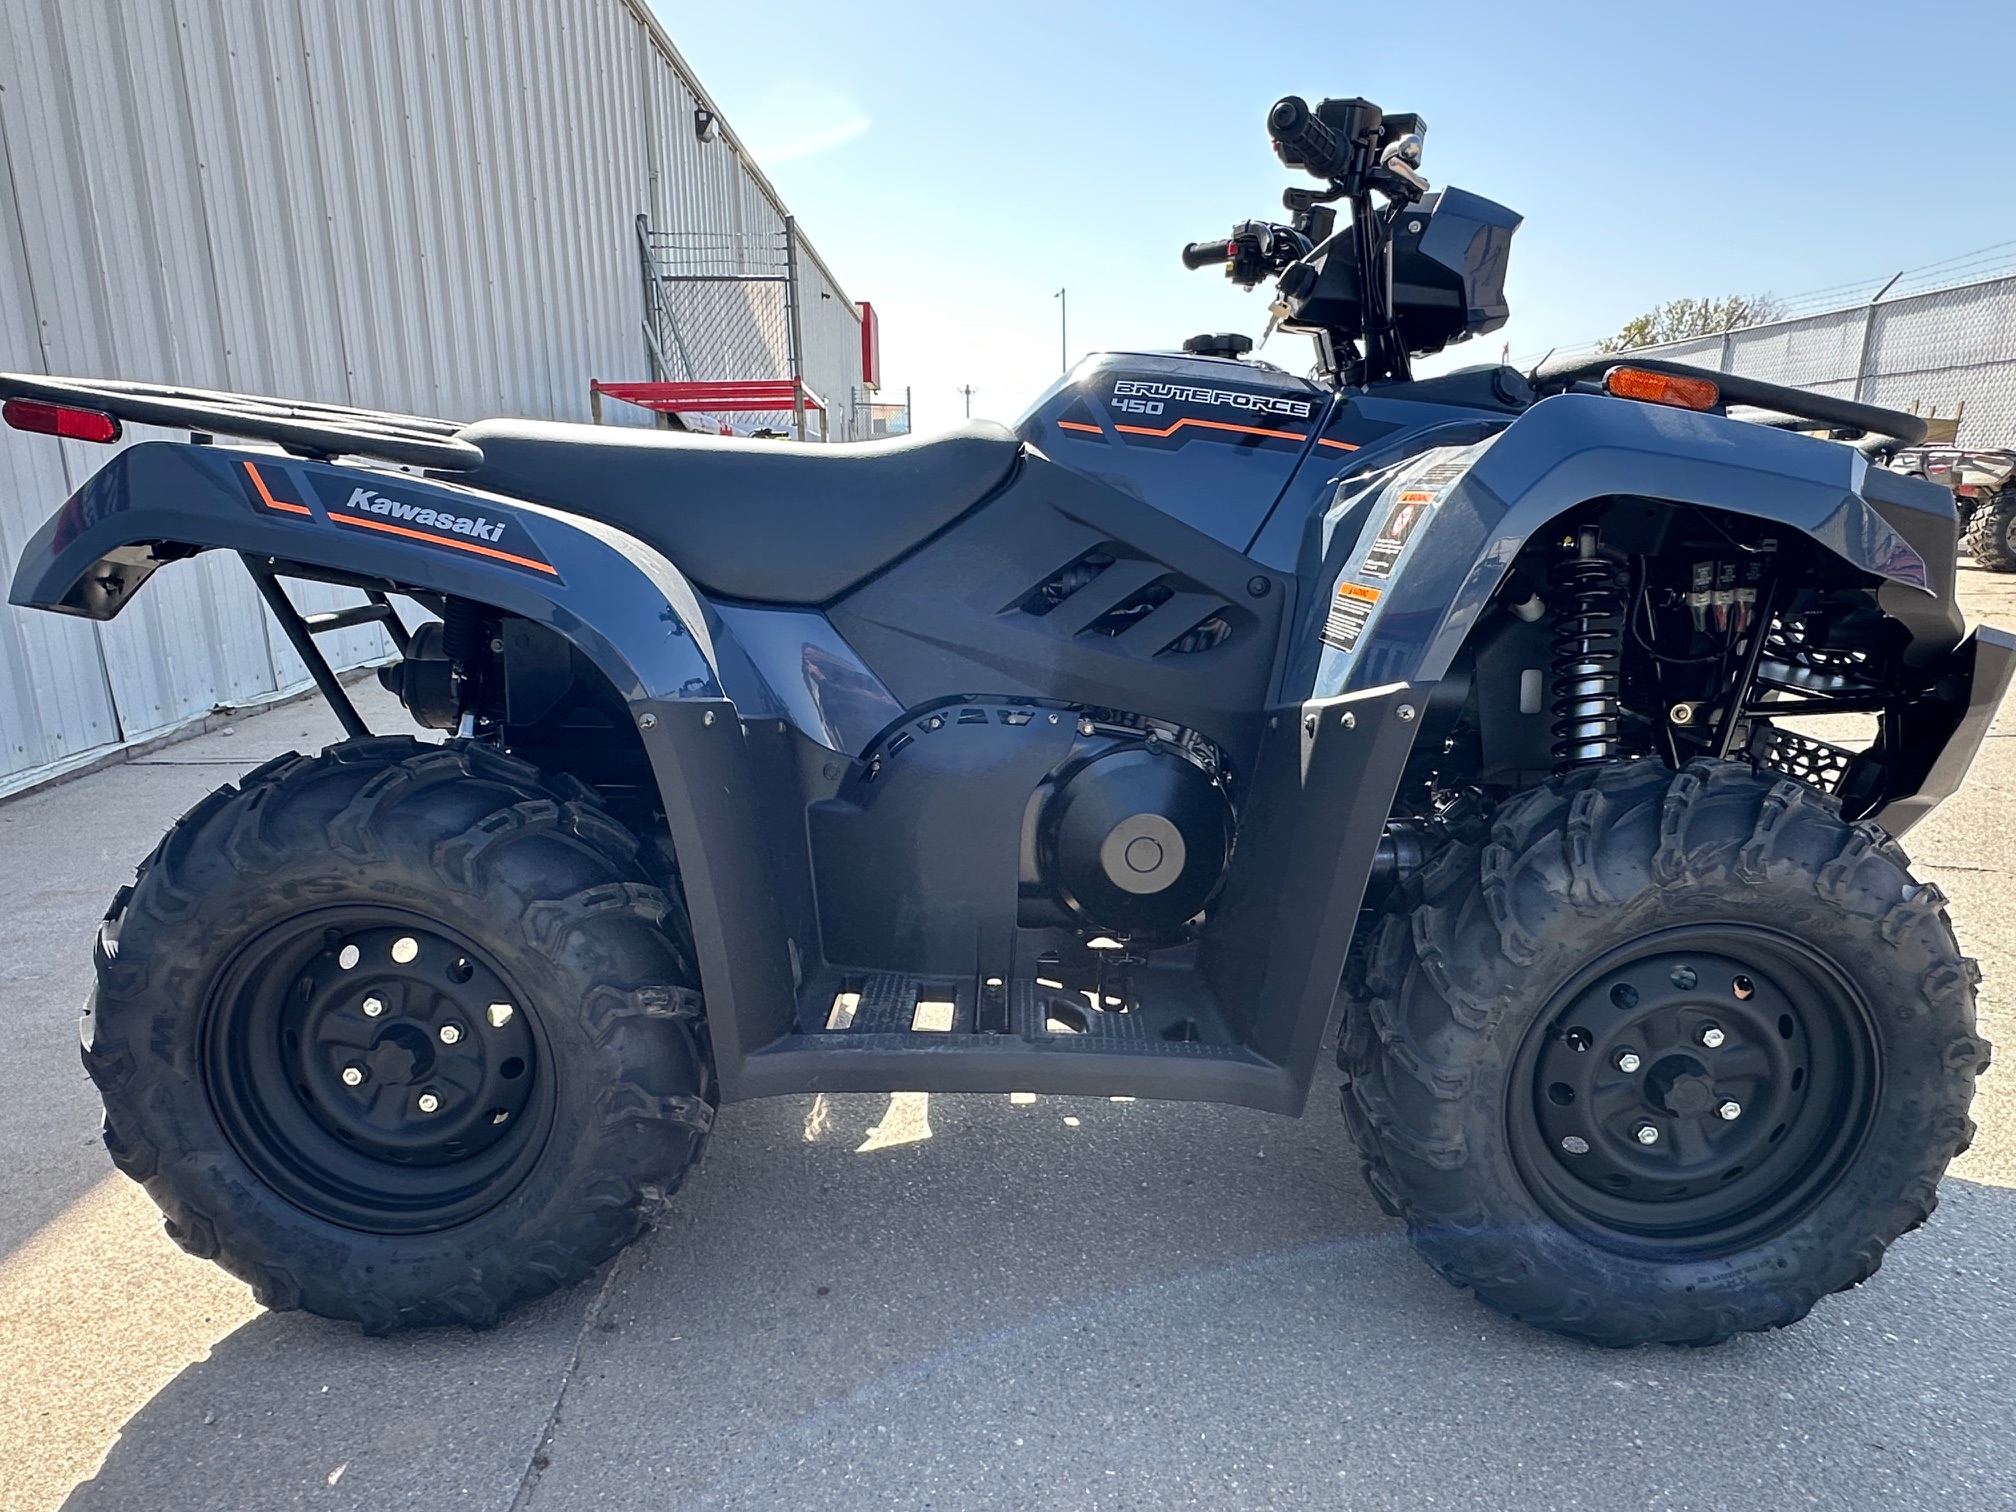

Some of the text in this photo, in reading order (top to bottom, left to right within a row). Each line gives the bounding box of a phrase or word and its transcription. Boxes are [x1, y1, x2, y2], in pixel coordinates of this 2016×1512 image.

[1111, 398, 1164, 415] 450
[1114, 381, 1311, 417] BRUTE FORCE
[346, 487, 506, 543] Kawasaki
